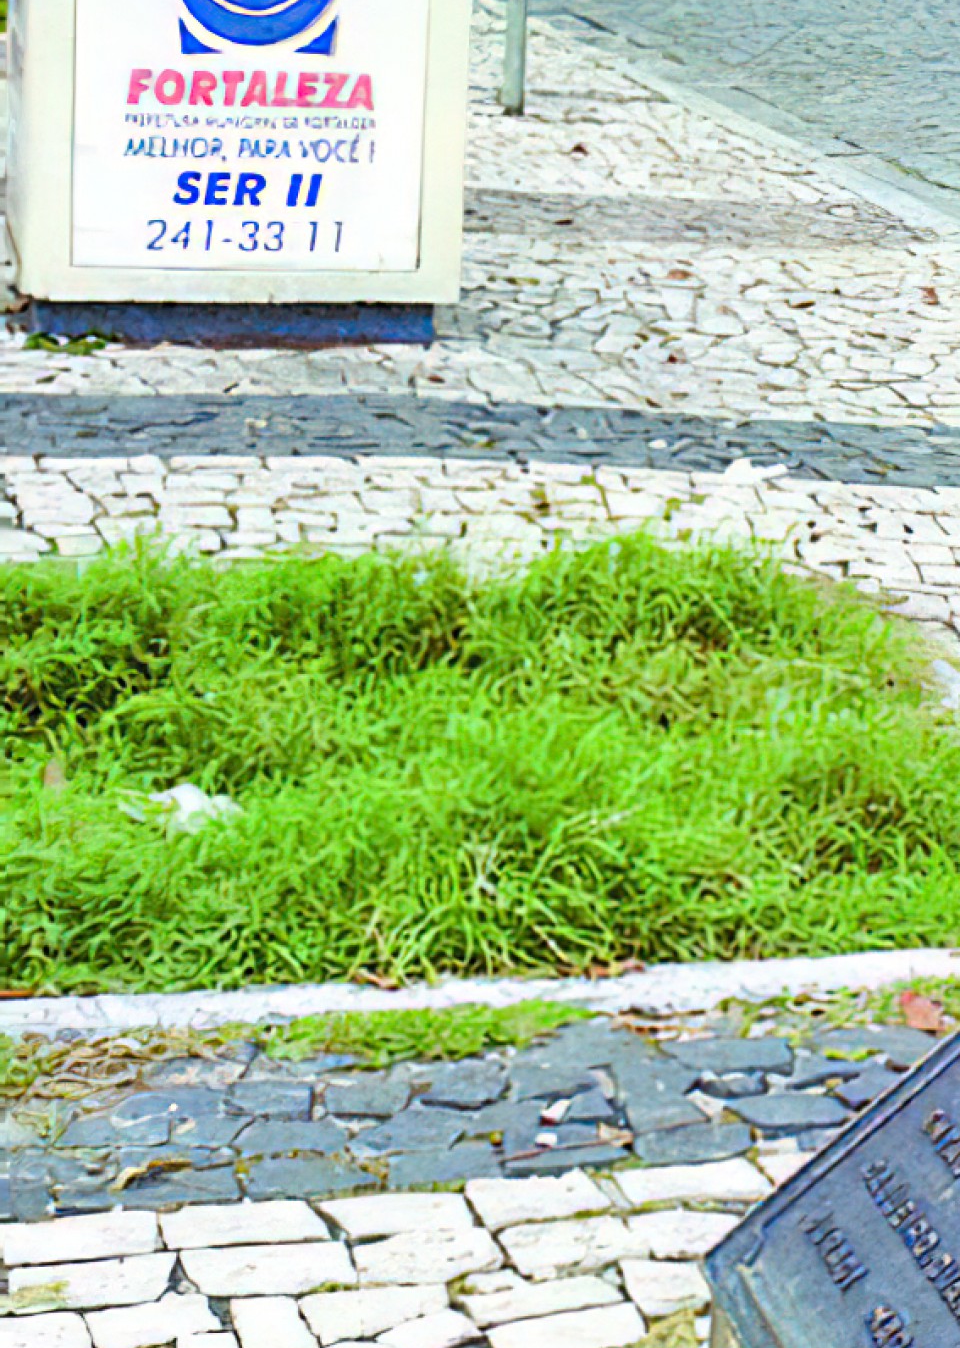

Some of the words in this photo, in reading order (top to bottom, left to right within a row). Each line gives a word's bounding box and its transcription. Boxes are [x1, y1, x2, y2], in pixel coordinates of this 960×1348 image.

[125, 68, 375, 111] FORTALEZA
[238, 137, 292, 158] PARA
[172, 170, 267, 206] SER
[286, 173, 323, 207] II
